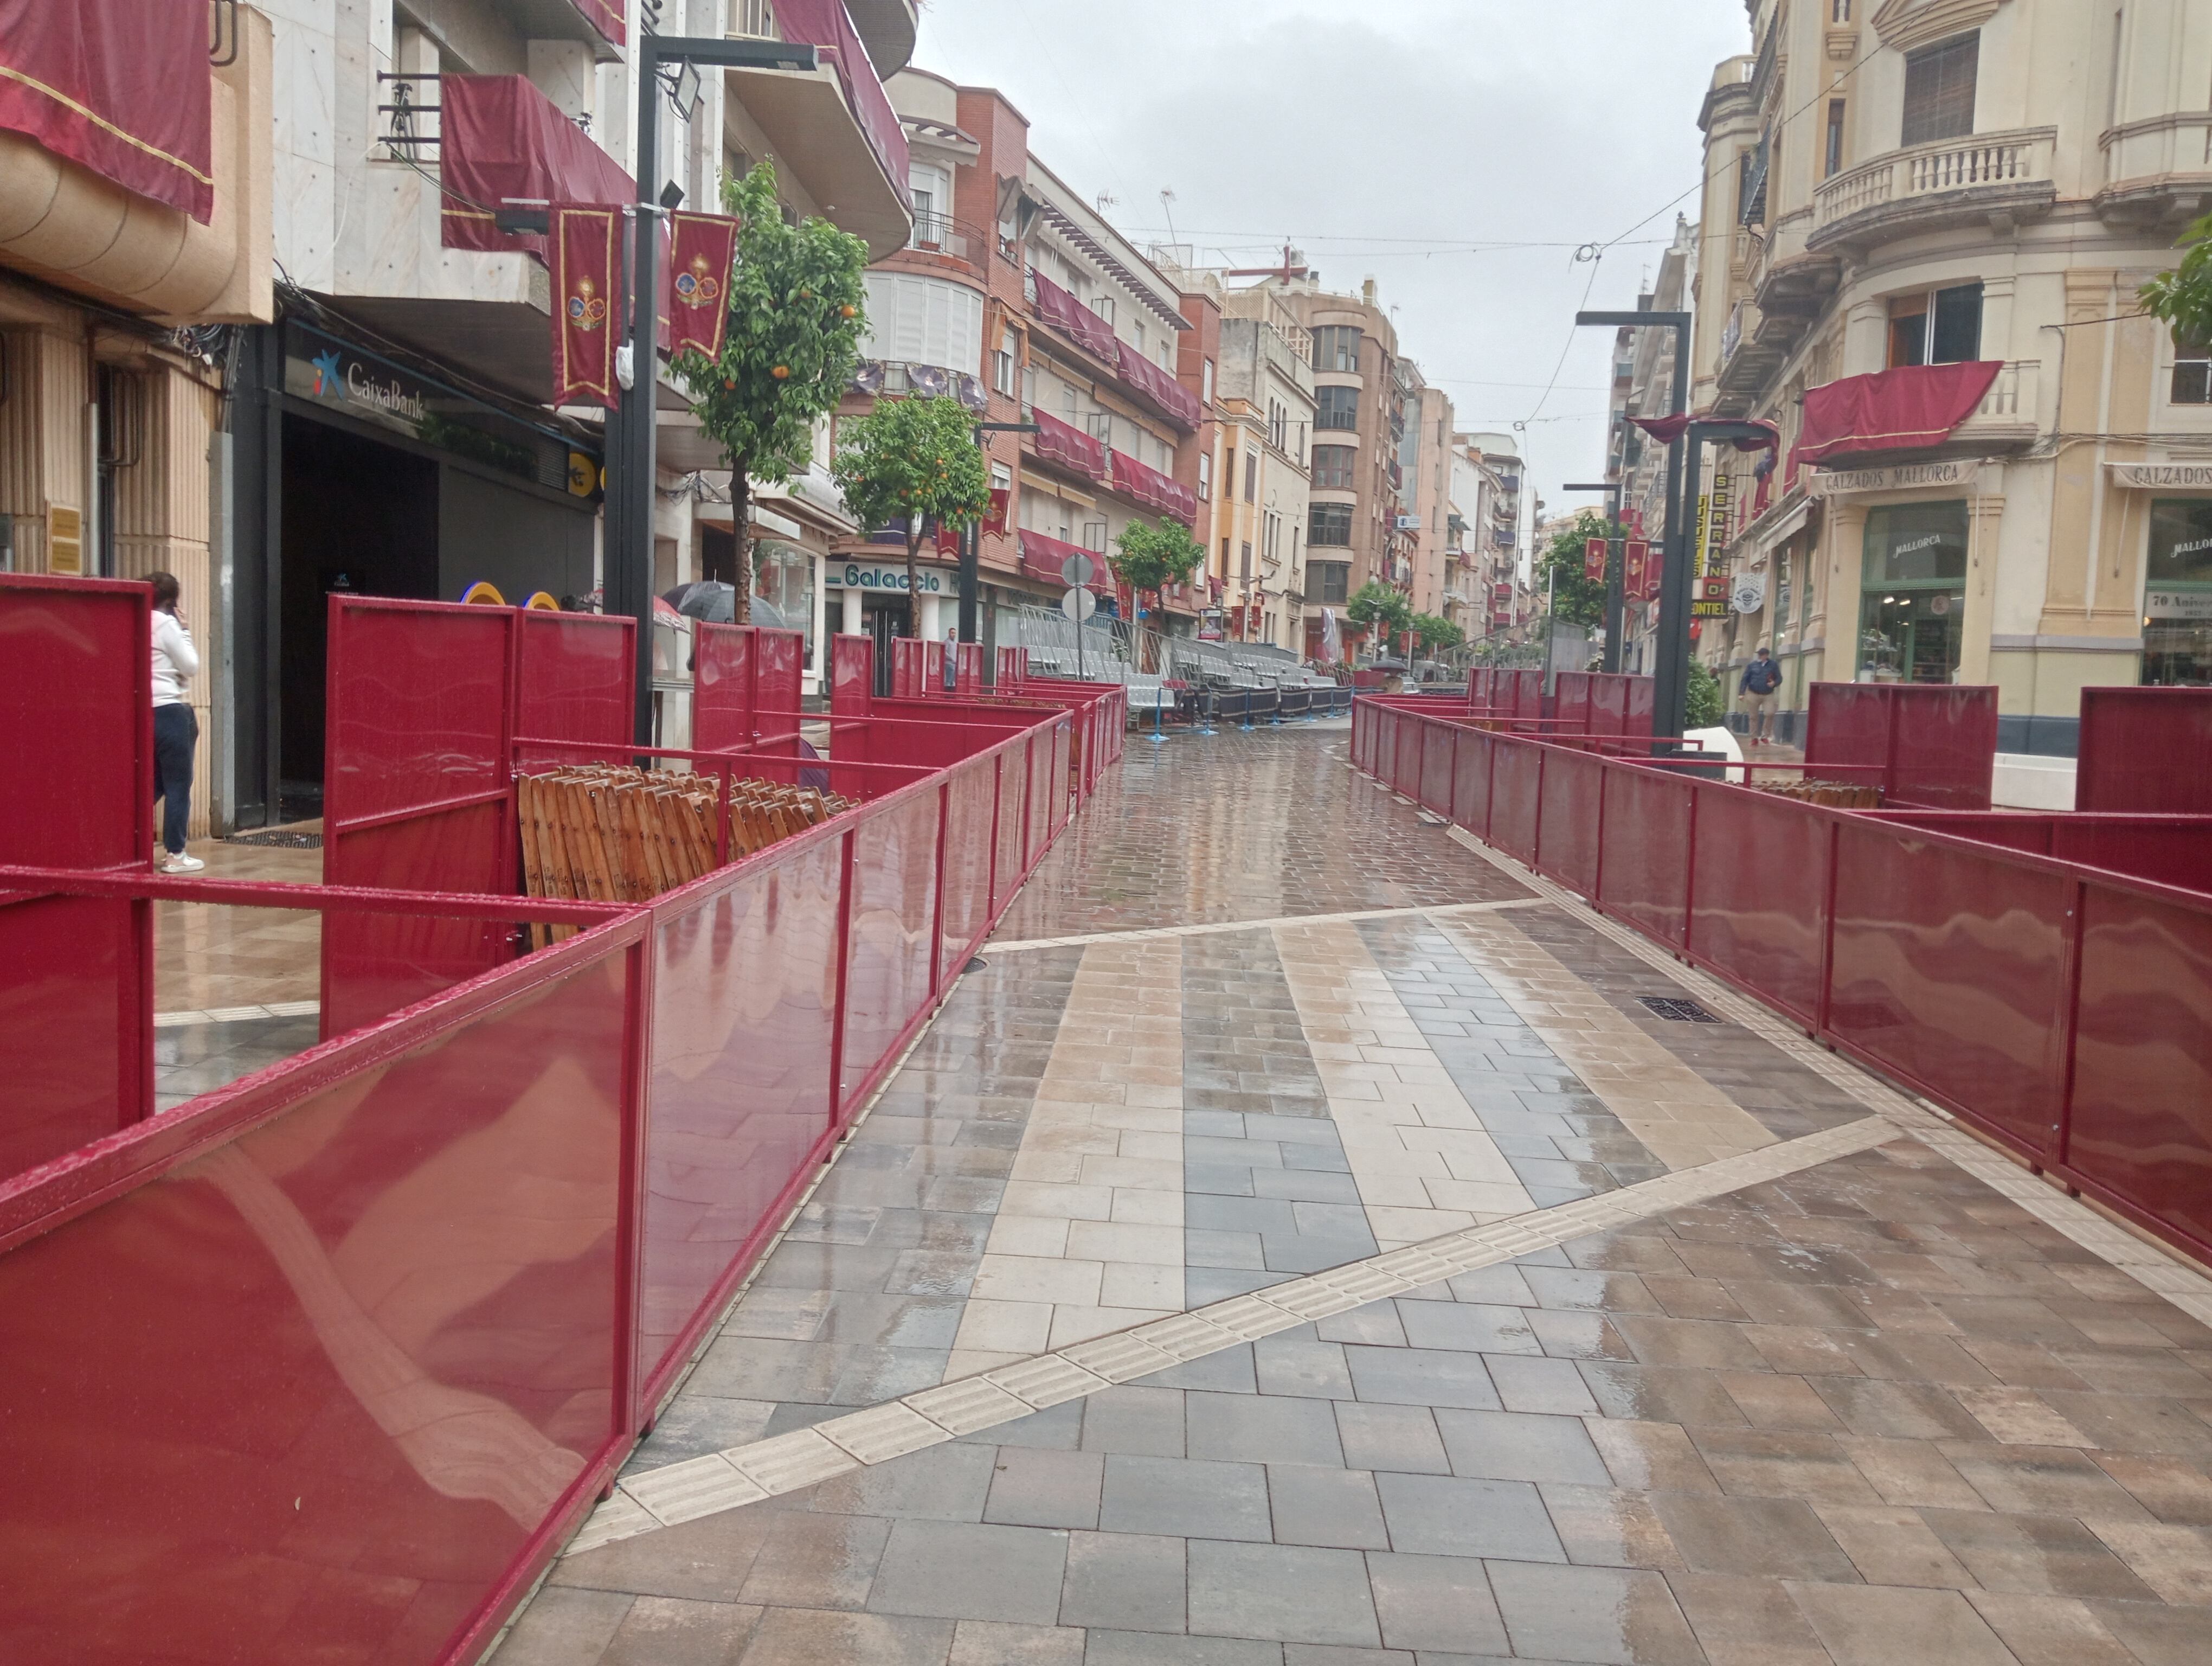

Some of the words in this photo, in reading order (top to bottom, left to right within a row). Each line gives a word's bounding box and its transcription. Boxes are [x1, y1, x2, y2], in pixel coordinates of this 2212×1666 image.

[348, 362, 423, 421] CaixaBank
[1825, 471, 1883, 489] CALZADOS
[1892, 464, 1958, 488] MALLORCA
[2134, 467, 2212, 484] CALZADOS
[1708, 477, 1727, 595] SERRANO
[1893, 534, 1941, 559] MALLORCA
[1691, 602, 1726, 615] ONTIEL
